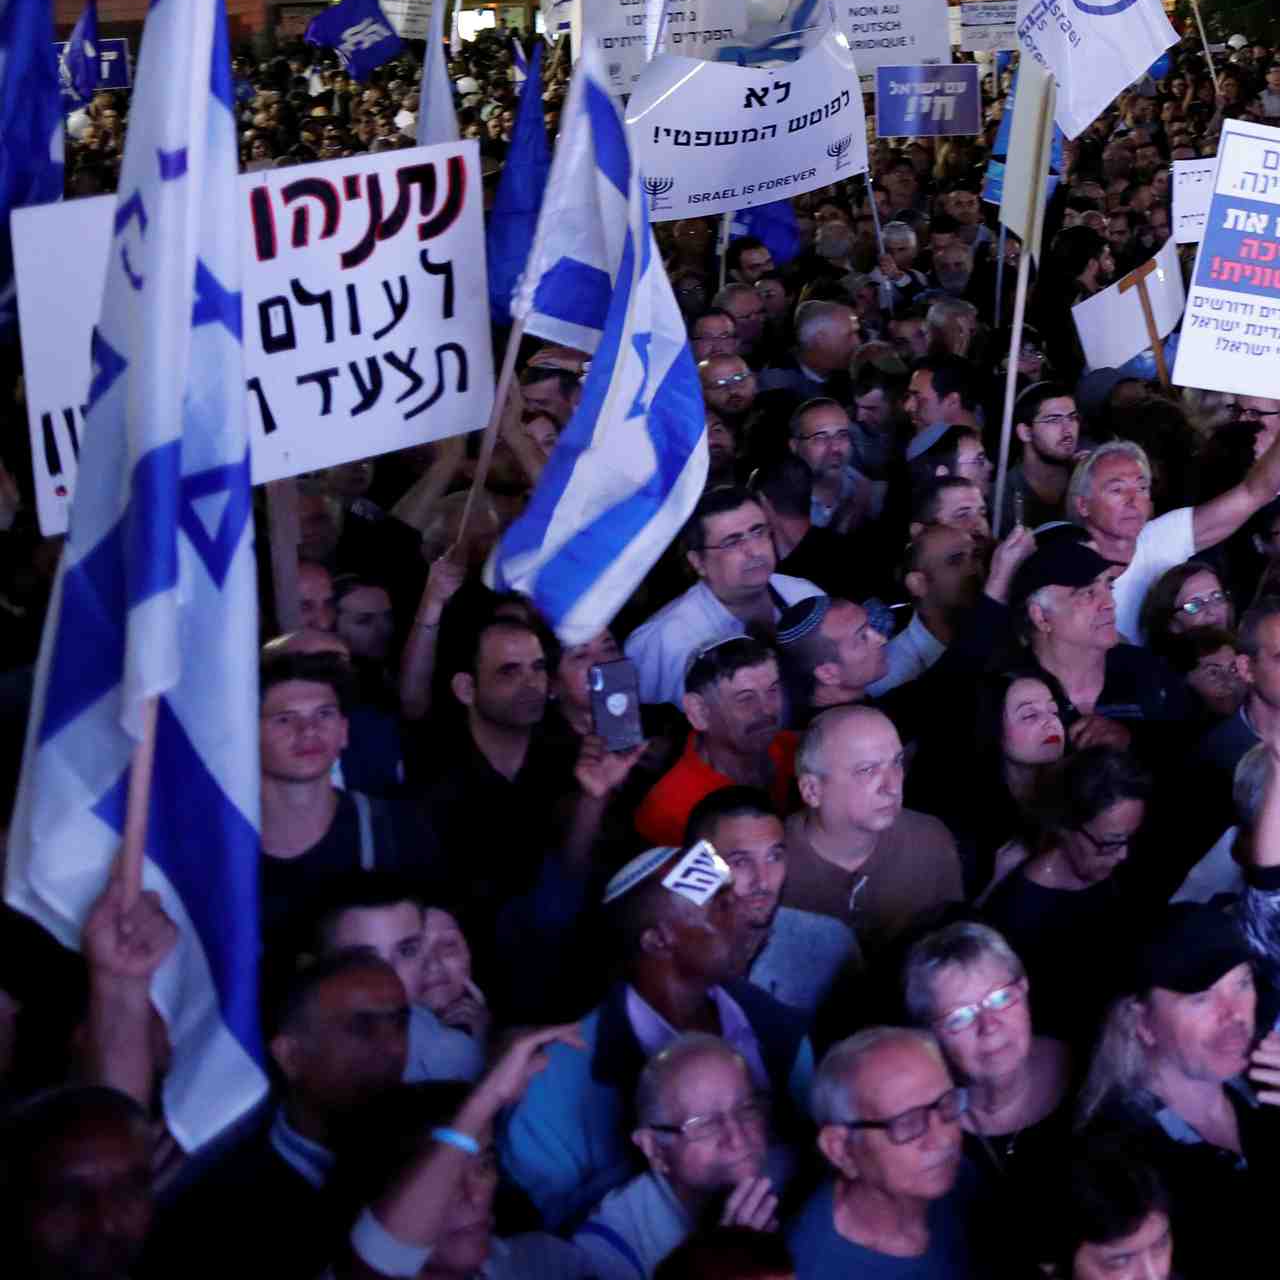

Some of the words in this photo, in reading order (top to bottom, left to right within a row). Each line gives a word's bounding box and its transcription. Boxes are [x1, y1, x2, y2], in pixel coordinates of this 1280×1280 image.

[849, 6, 878, 17] NON
[882, 4, 899, 15] AU
[852, 21, 901, 34] PUTSCH
[744, 81, 791, 108] לא
[788, 89, 850, 133] לפוטש
[653, 124, 778, 147] המשפטי!
[687, 188, 738, 205] ISRAEL
[742, 184, 756, 196] IS
[758, 168, 817, 191] FOREVER
[249, 155, 466, 271] נתניהו
[1223, 208, 1270, 234] את
[258, 249, 454, 355] לעולם
[1192, 295, 1254, 315] ודורשים
[1191, 314, 1241, 332] ישראל
[1215, 336, 1271, 357] ישראל!
[297, 342, 469, 421] תצעד
